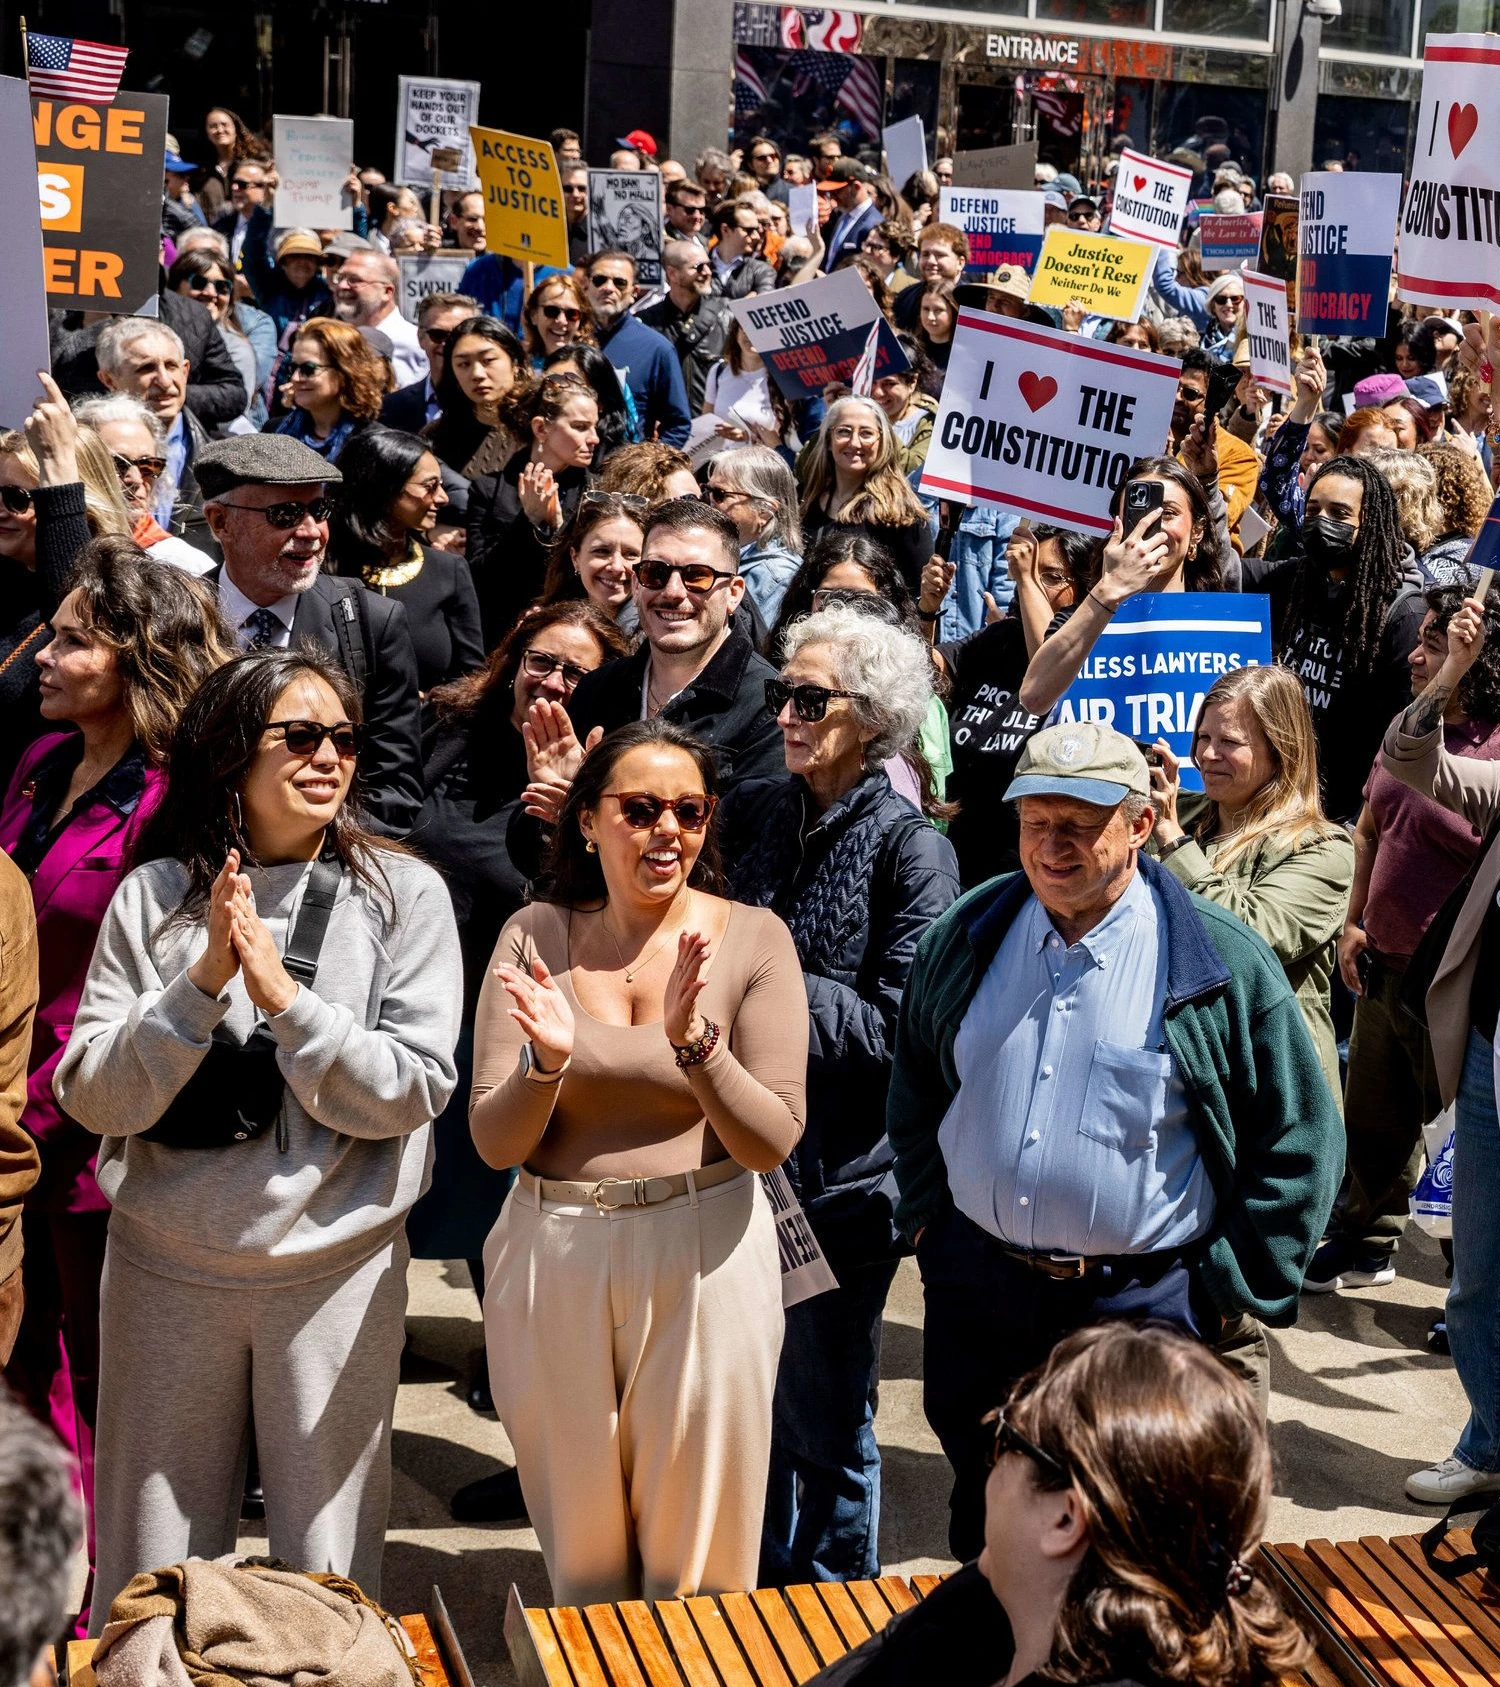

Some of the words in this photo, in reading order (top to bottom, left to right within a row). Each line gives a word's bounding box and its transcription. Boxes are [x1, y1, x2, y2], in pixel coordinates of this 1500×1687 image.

[986, 34, 1079, 65] ENTRANCE
[411, 101, 445, 113] HANDS
[446, 102, 466, 114] OUT
[412, 88, 436, 101] KEEP
[440, 90, 467, 103] YOUR
[415, 123, 460, 137] DOCKETS
[420, 113, 433, 124] OF
[435, 114, 456, 125] OUR
[1428, 100, 1440, 157] I
[482, 139, 550, 171] ACCESS
[506, 167, 532, 188] TO
[489, 187, 559, 218] JUSTICE
[951, 197, 999, 214] DEFEND
[1154, 181, 1175, 204] THE
[1302, 191, 1325, 221] FEND
[964, 217, 1016, 234] JUSTICE
[1115, 194, 1180, 231] CONSTITUTION
[1302, 224, 1348, 255] USTICE
[969, 249, 1033, 268] EMOCRACY
[1068, 244, 1124, 265] Justice
[1044, 256, 1100, 278] Doesn't
[1102, 266, 1138, 285] Rest
[1050, 276, 1089, 291] Neither
[1090, 283, 1104, 294] Do
[1107, 286, 1122, 297] We
[747, 299, 811, 330] DEFEND
[1257, 301, 1278, 330] THE
[780, 312, 847, 348] JUSTICE
[772, 344, 827, 371] DEFEND
[979, 360, 996, 401] I
[1078, 385, 1138, 437] THE
[941, 410, 1145, 493] CONSTITUTIO
[1141, 652, 1242, 676] LAWYERS
[1125, 690, 1208, 735] TRIA
